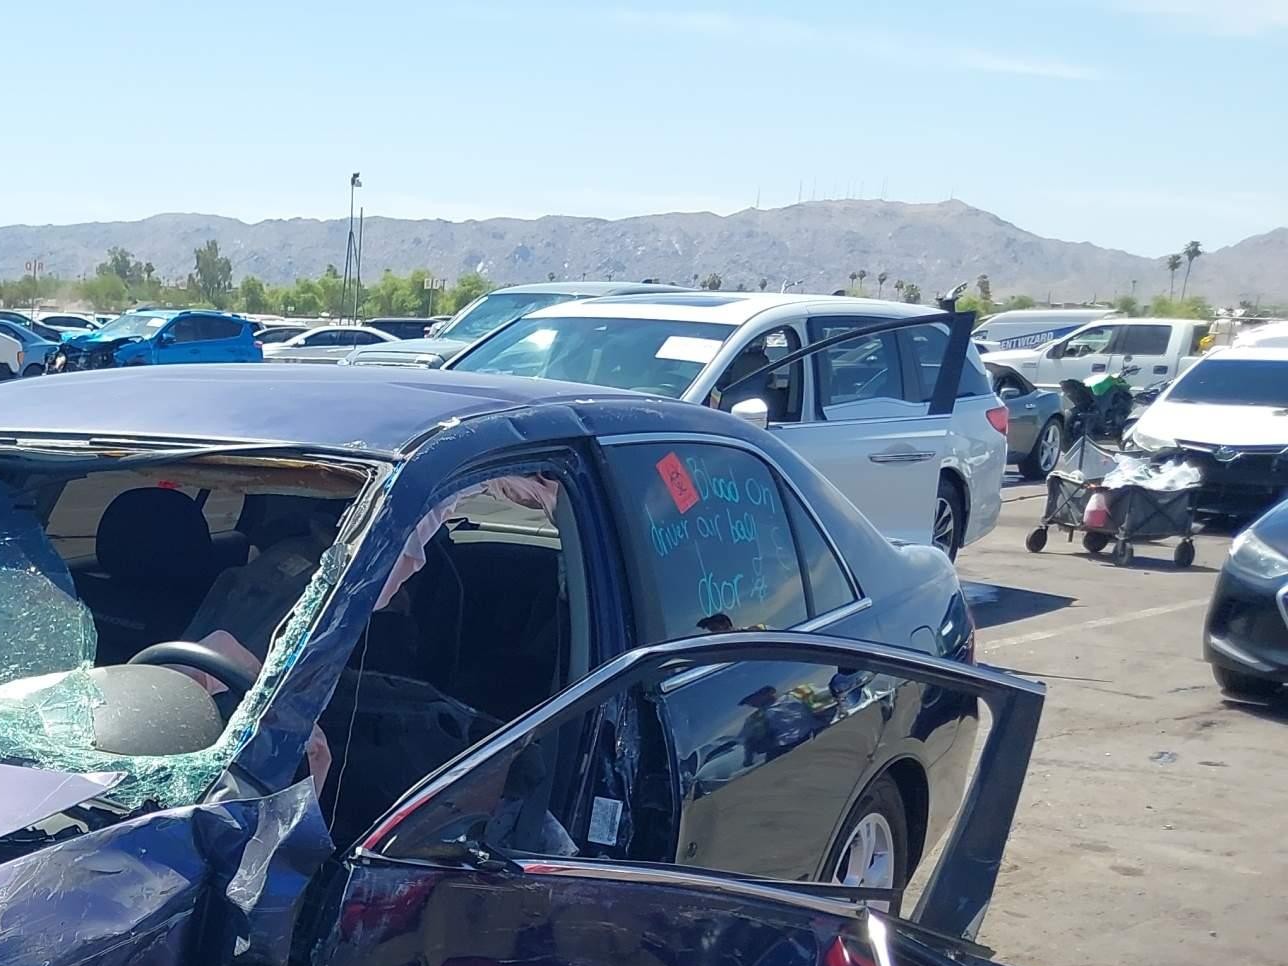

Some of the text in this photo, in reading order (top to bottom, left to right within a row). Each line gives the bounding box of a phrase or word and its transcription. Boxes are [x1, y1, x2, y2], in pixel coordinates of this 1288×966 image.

[686, 457, 740, 502] Blood
[645, 503, 689, 557] driver
[696, 513, 723, 542] air
[694, 540, 745, 616] door
